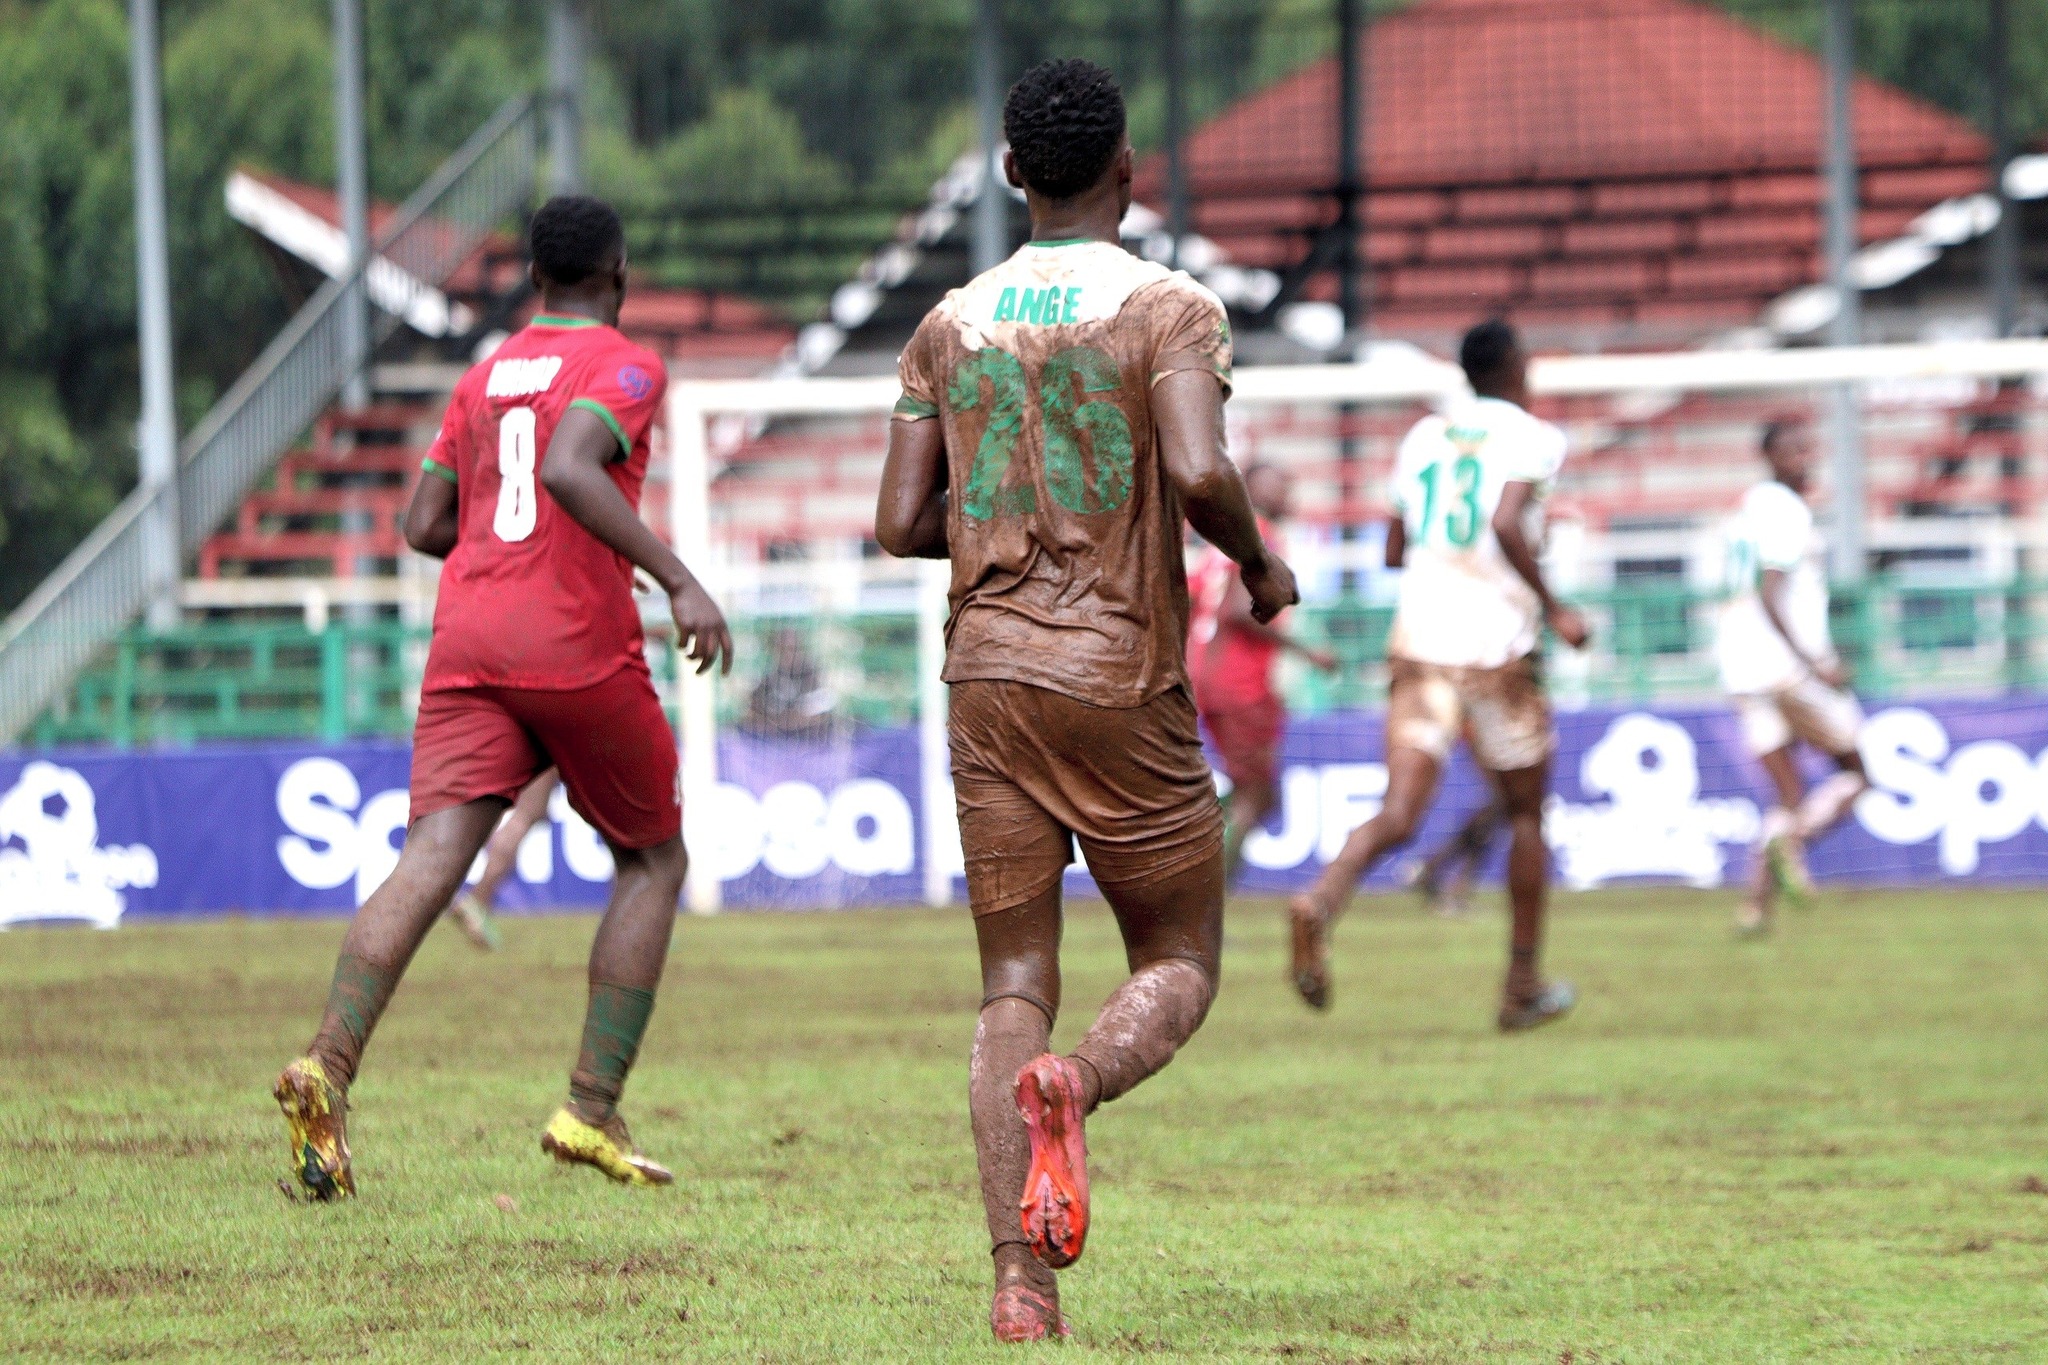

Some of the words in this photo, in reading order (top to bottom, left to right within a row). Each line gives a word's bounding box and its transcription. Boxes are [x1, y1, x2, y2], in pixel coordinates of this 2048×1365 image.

[993, 286, 1083, 327] ANGE
[493, 406, 537, 542] 8
[949, 346, 1134, 521] 26
[1413, 454, 1484, 549] 13
[1853, 707, 2048, 877] Sp
